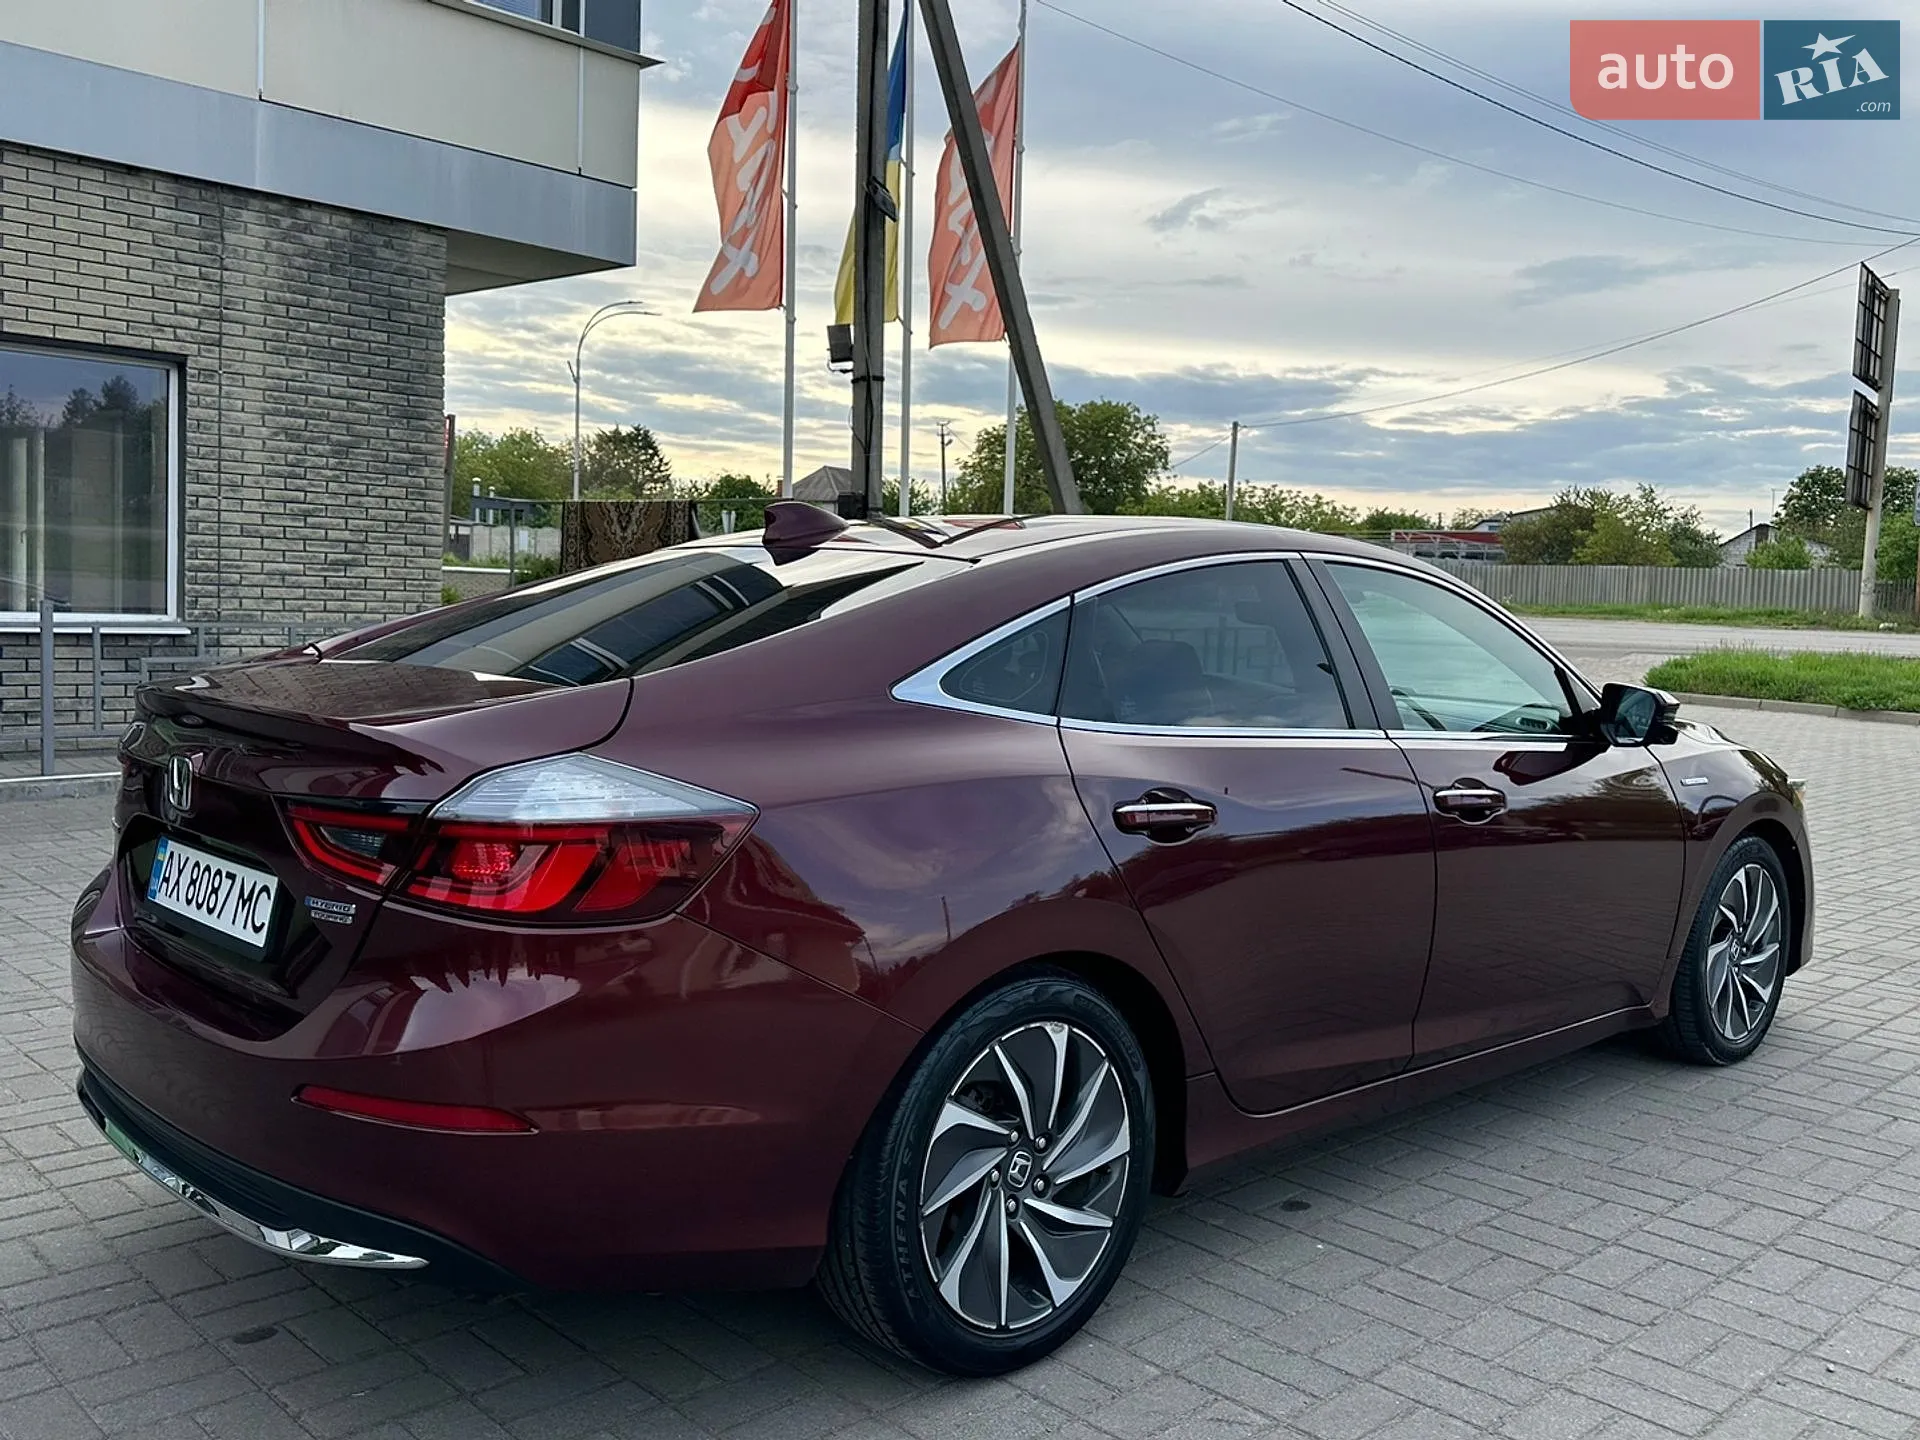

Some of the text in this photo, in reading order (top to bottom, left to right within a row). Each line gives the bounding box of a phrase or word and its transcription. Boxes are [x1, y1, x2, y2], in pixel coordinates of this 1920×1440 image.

[158, 850, 272, 935] AX 8087 MC
